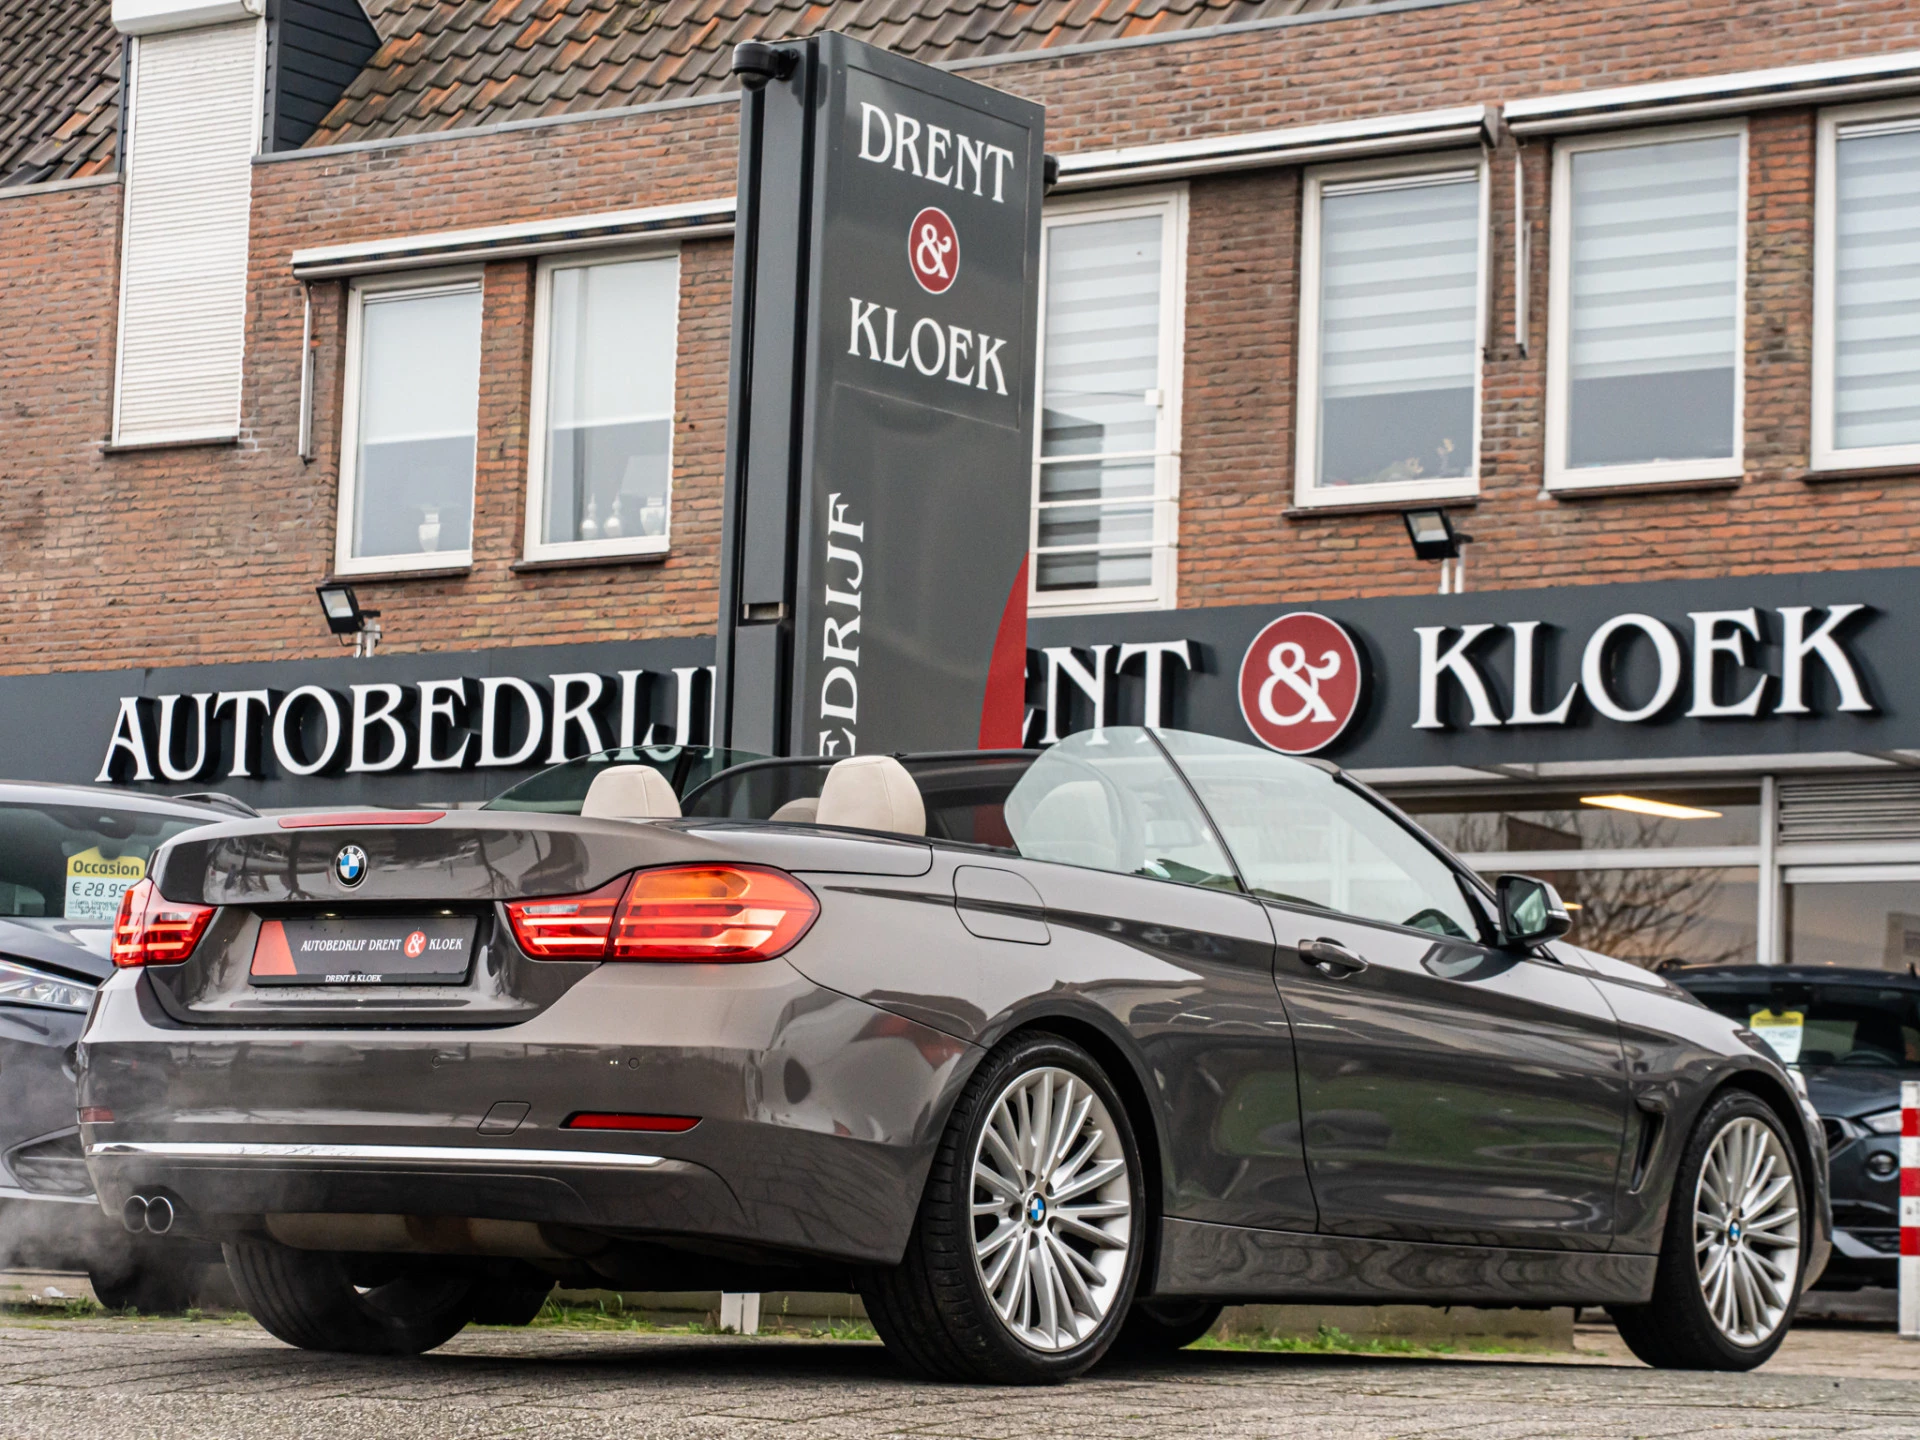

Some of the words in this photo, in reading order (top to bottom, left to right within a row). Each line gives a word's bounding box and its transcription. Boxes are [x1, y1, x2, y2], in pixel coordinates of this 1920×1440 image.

[858, 102, 1014, 203] DRENT
[916, 223, 951, 280] &
[848, 297, 1008, 396] KLOEK
[95, 665, 717, 782] AUTOBEDRIJ
[1022, 639, 1191, 746] NT
[1258, 641, 1341, 727] &
[1412, 603, 1873, 729] KLOEK
[73, 860, 139, 876] Occasion
[72, 882, 81, 896] €
[301, 939, 366, 952] AUTOBEDRIJF
[368, 938, 402, 951] DRENT
[407, 933, 425, 954] &
[429, 938, 463, 950] KLOEK
[325, 974, 350, 983] DRENT
[356, 974, 382, 983] KLOEK
